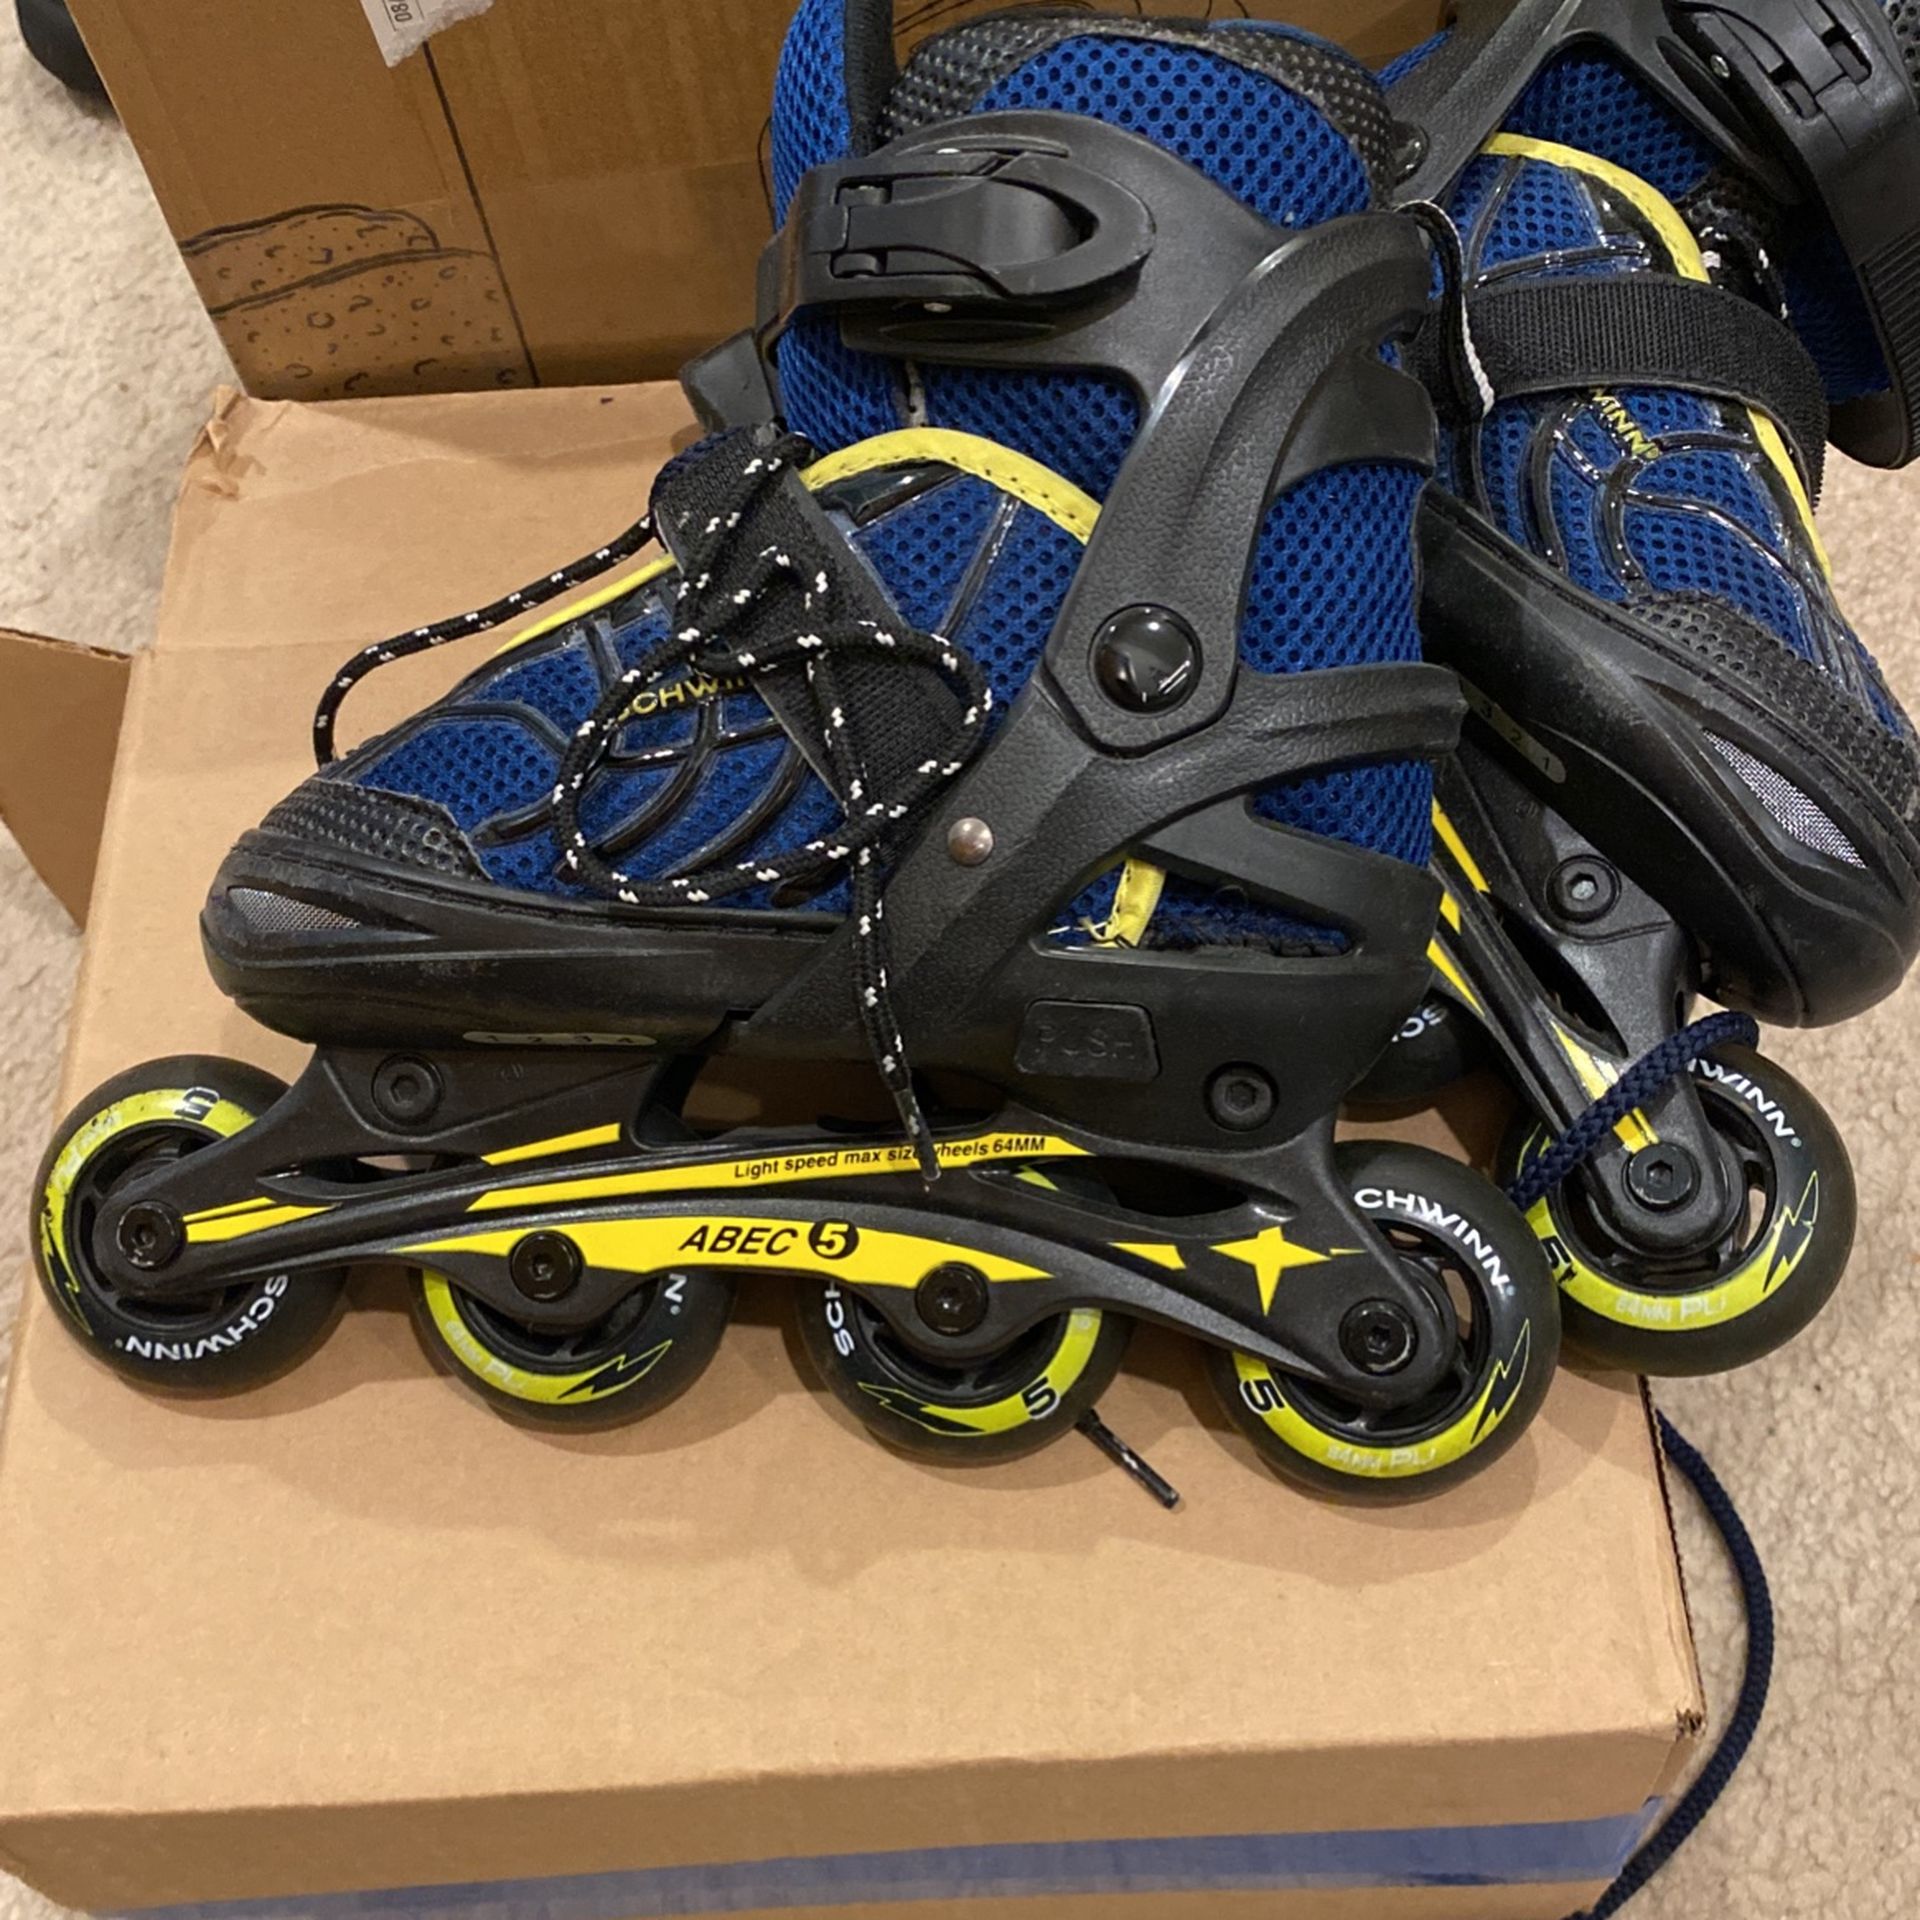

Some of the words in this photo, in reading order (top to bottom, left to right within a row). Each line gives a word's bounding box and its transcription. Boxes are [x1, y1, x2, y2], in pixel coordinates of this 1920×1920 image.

[389, 0, 413, 22] 80
[1391, 1002, 1449, 1043] SC
[173, 1086, 221, 1123] 5
[734, 1161, 779, 1180] Light
[784, 1151, 839, 1174] speed
[844, 1149, 882, 1164] max
[932, 1138, 989, 1158] heels
[993, 1136, 1046, 1155] 64MM
[678, 1224, 799, 1255] ABEC
[815, 1222, 850, 1253] 5
[125, 1274, 288, 1361] SCHWINN
[1022, 1376, 1061, 1420] 5
[1239, 1378, 1286, 1415] 5
